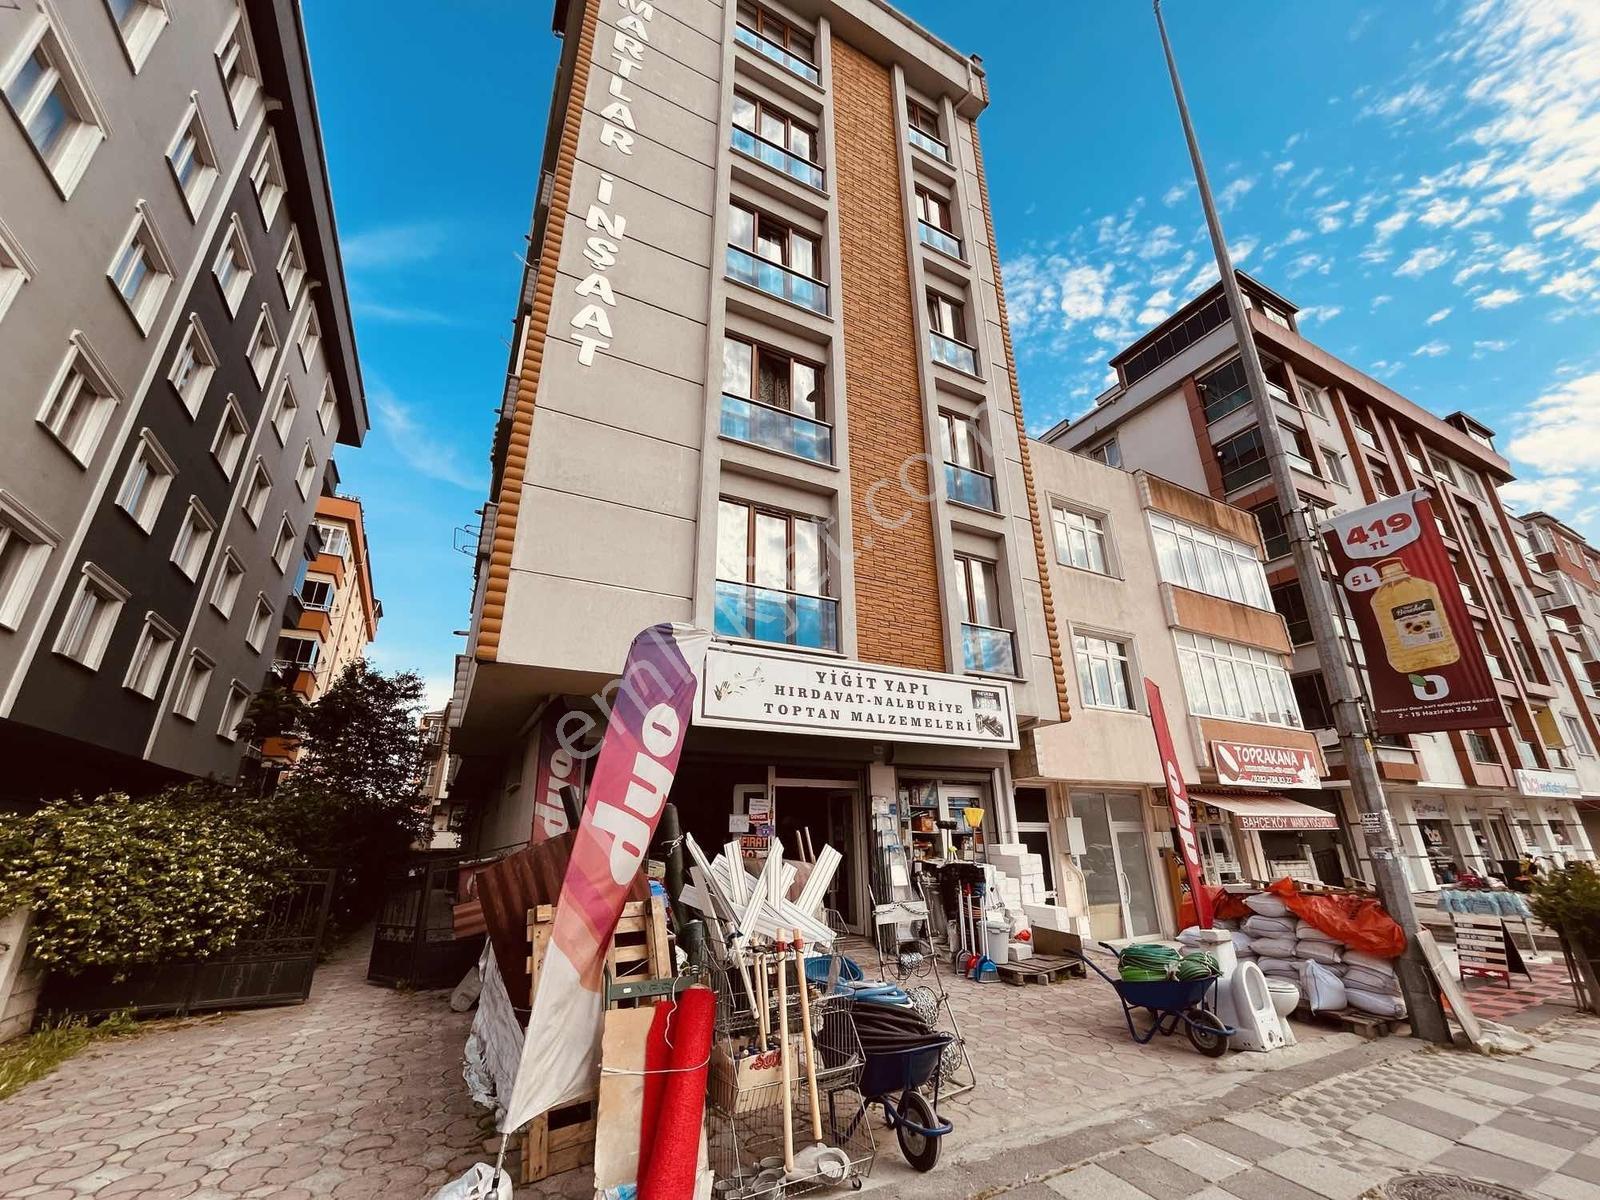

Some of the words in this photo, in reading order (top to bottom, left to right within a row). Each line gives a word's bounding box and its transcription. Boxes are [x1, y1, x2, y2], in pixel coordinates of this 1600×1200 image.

[569, 173, 627, 367] İNŞAAT
[1347, 512, 1413, 545] 419
[1369, 540, 1389, 550] TL
[1351, 575, 1362, 587] 5
[815, 669, 877, 690] YİĞİT
[884, 679, 929, 696] YAPI
[774, 684, 964, 714] HIRDAVAT-NALBURİYE
[1422, 708, 1454, 716] Haziran
[1456, 705, 1478, 713] 2026
[763, 702, 841, 721] TOPTAN
[850, 711, 972, 732] MALZEMELERİ
[1233, 746, 1300, 766] TOPRAKANA
[742, 837, 768, 848] FIRAT
